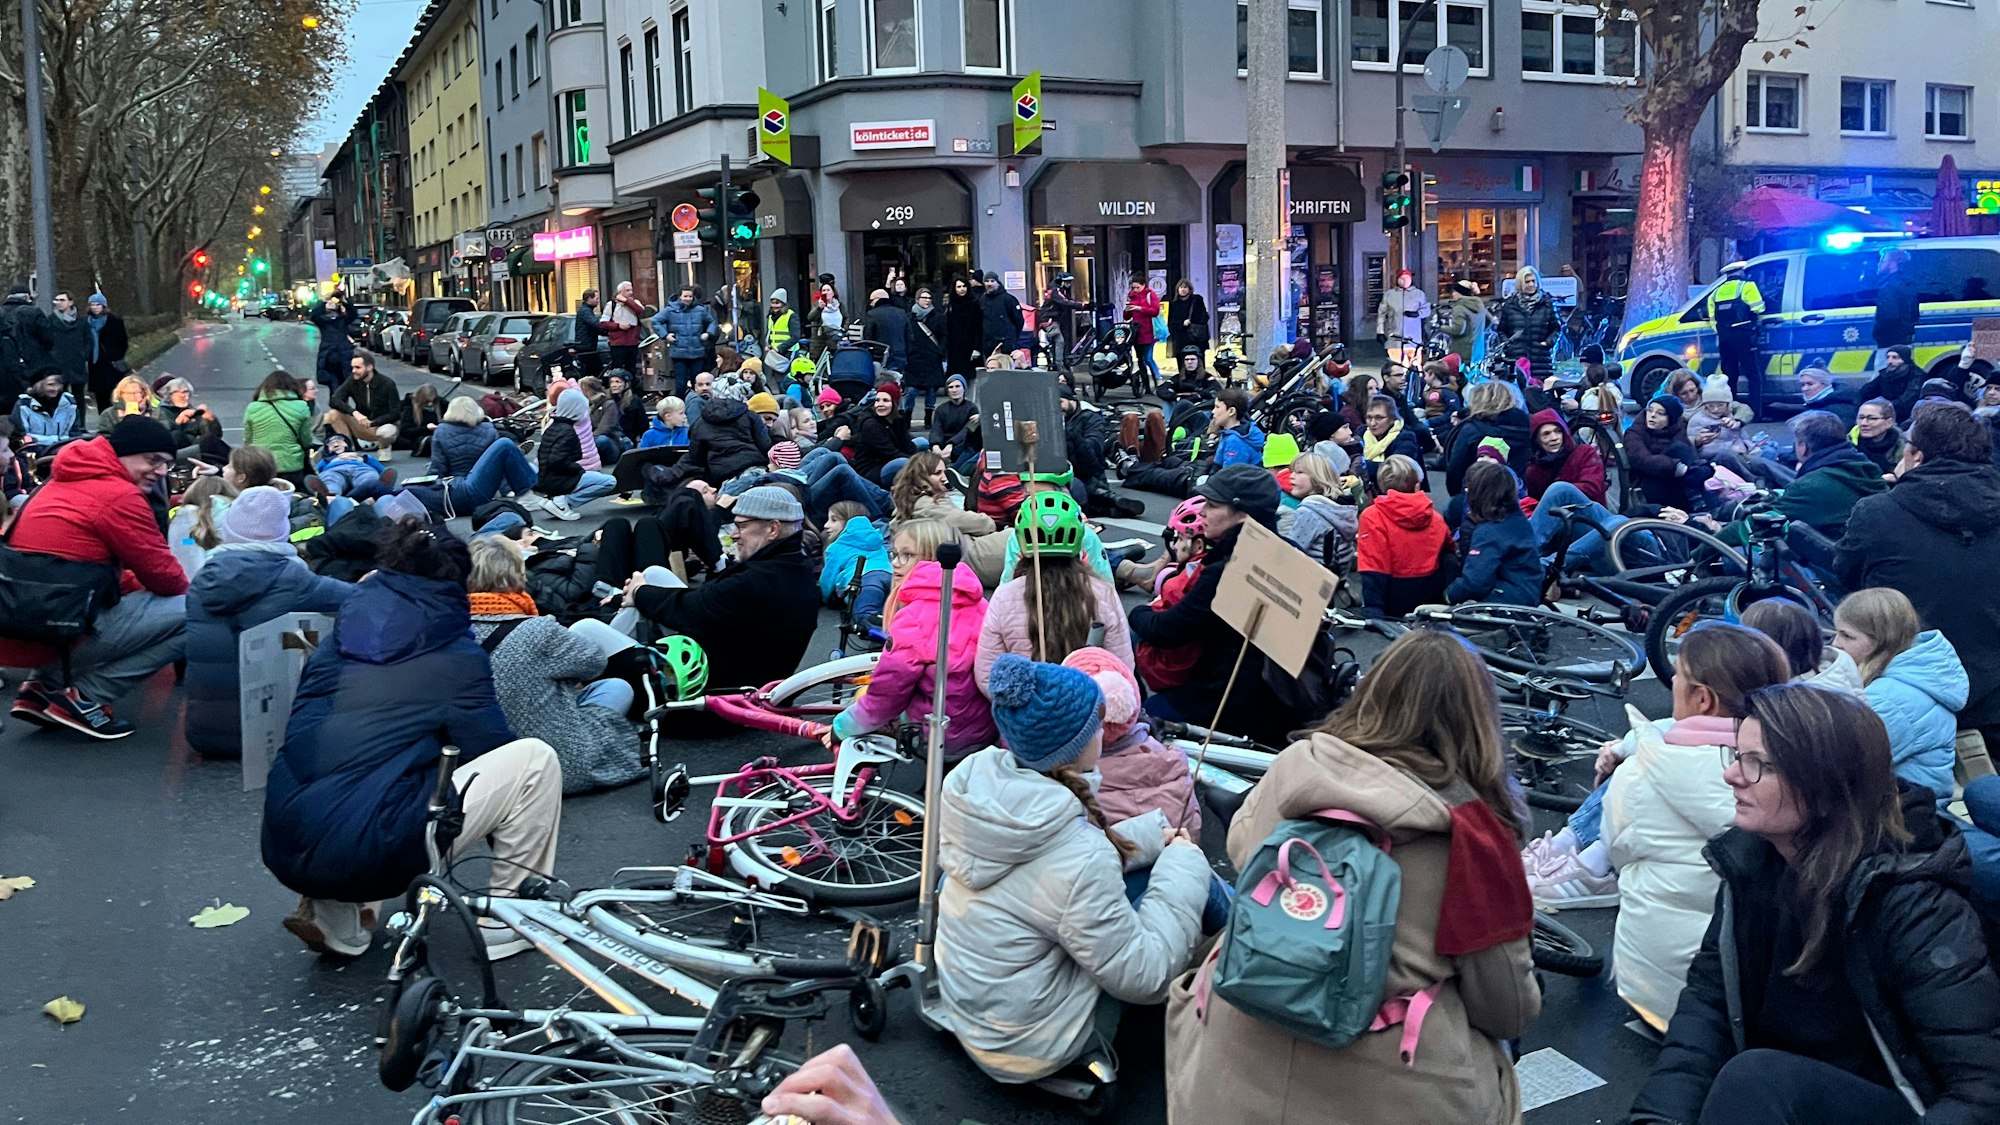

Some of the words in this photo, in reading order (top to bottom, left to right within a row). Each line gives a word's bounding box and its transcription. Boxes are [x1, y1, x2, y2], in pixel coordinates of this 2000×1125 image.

[885, 206, 914, 220] 269
[1098, 201, 1155, 215] WILDEN
[1290, 201, 1350, 214] CHRIFTEN
